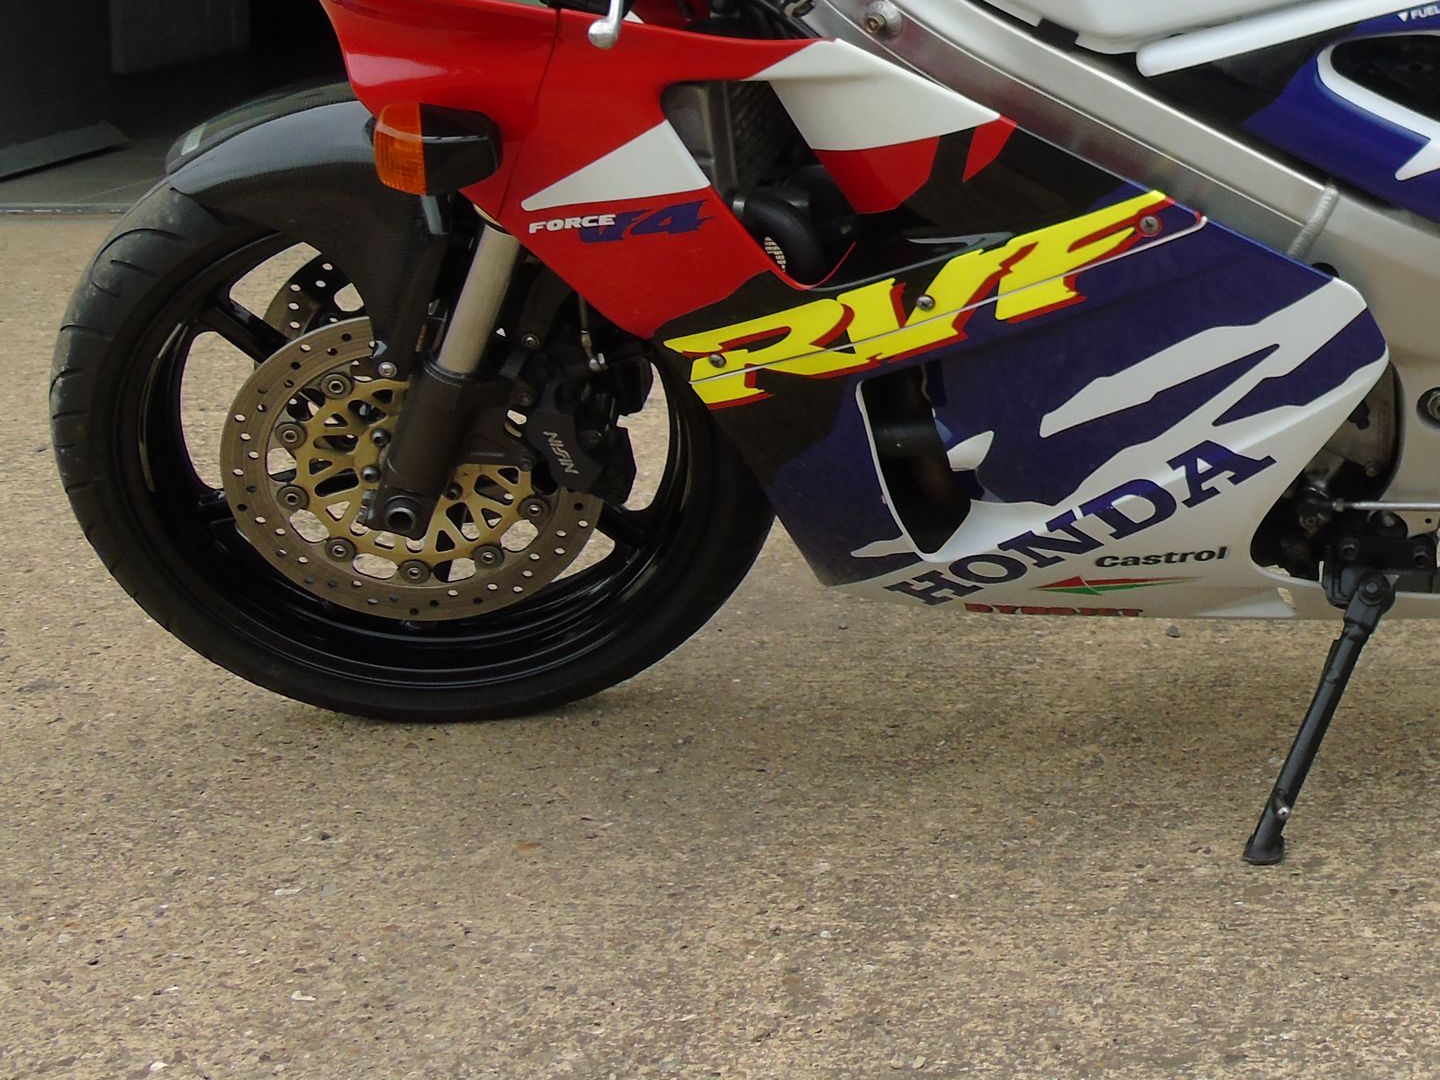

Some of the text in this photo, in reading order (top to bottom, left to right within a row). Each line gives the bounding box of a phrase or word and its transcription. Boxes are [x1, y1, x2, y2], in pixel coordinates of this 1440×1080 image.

[529, 214, 617, 234] FORCE
[663, 190, 1172, 409] RVF
[883, 439, 1277, 606] HONDA
[1095, 546, 1229, 569] Castrol
